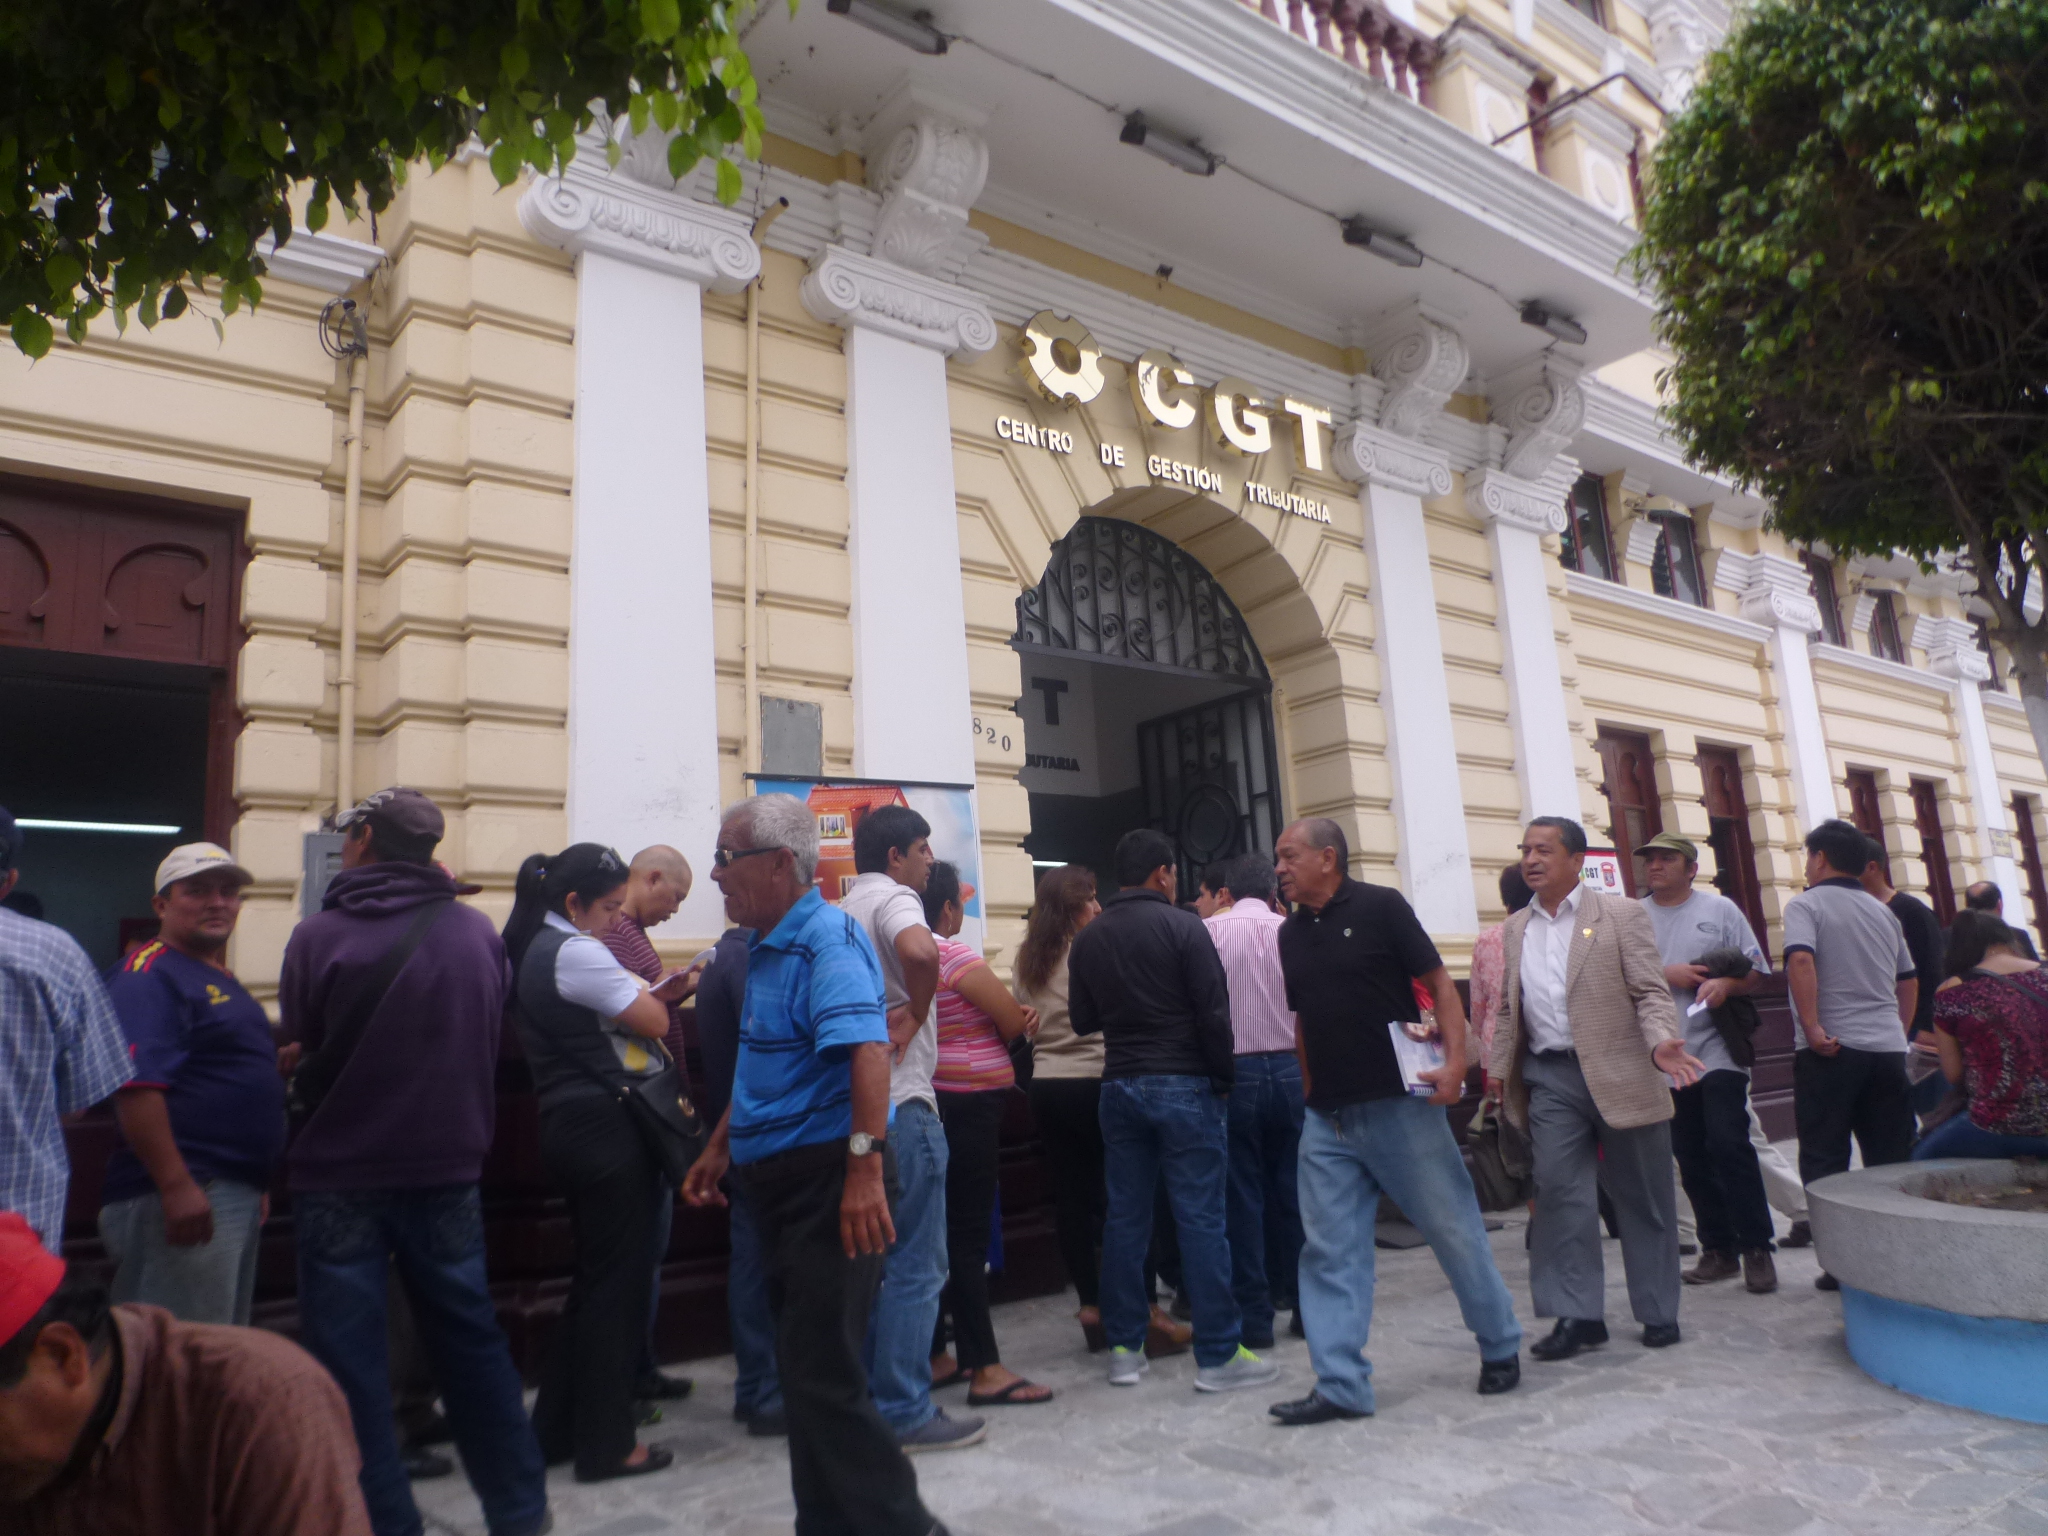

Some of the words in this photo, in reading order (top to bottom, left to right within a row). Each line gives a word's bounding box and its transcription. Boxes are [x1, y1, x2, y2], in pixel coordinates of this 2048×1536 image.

[1131, 350, 1331, 471] CGT
[996, 415, 1073, 454] CENTRO
[1101, 443, 1125, 467] DE
[1148, 455, 1223, 494] GESTIÓN
[1245, 481, 1331, 524] TRIBUTARIA
[973, 717, 1011, 752] 820
[1584, 867, 1599, 879] CGT
